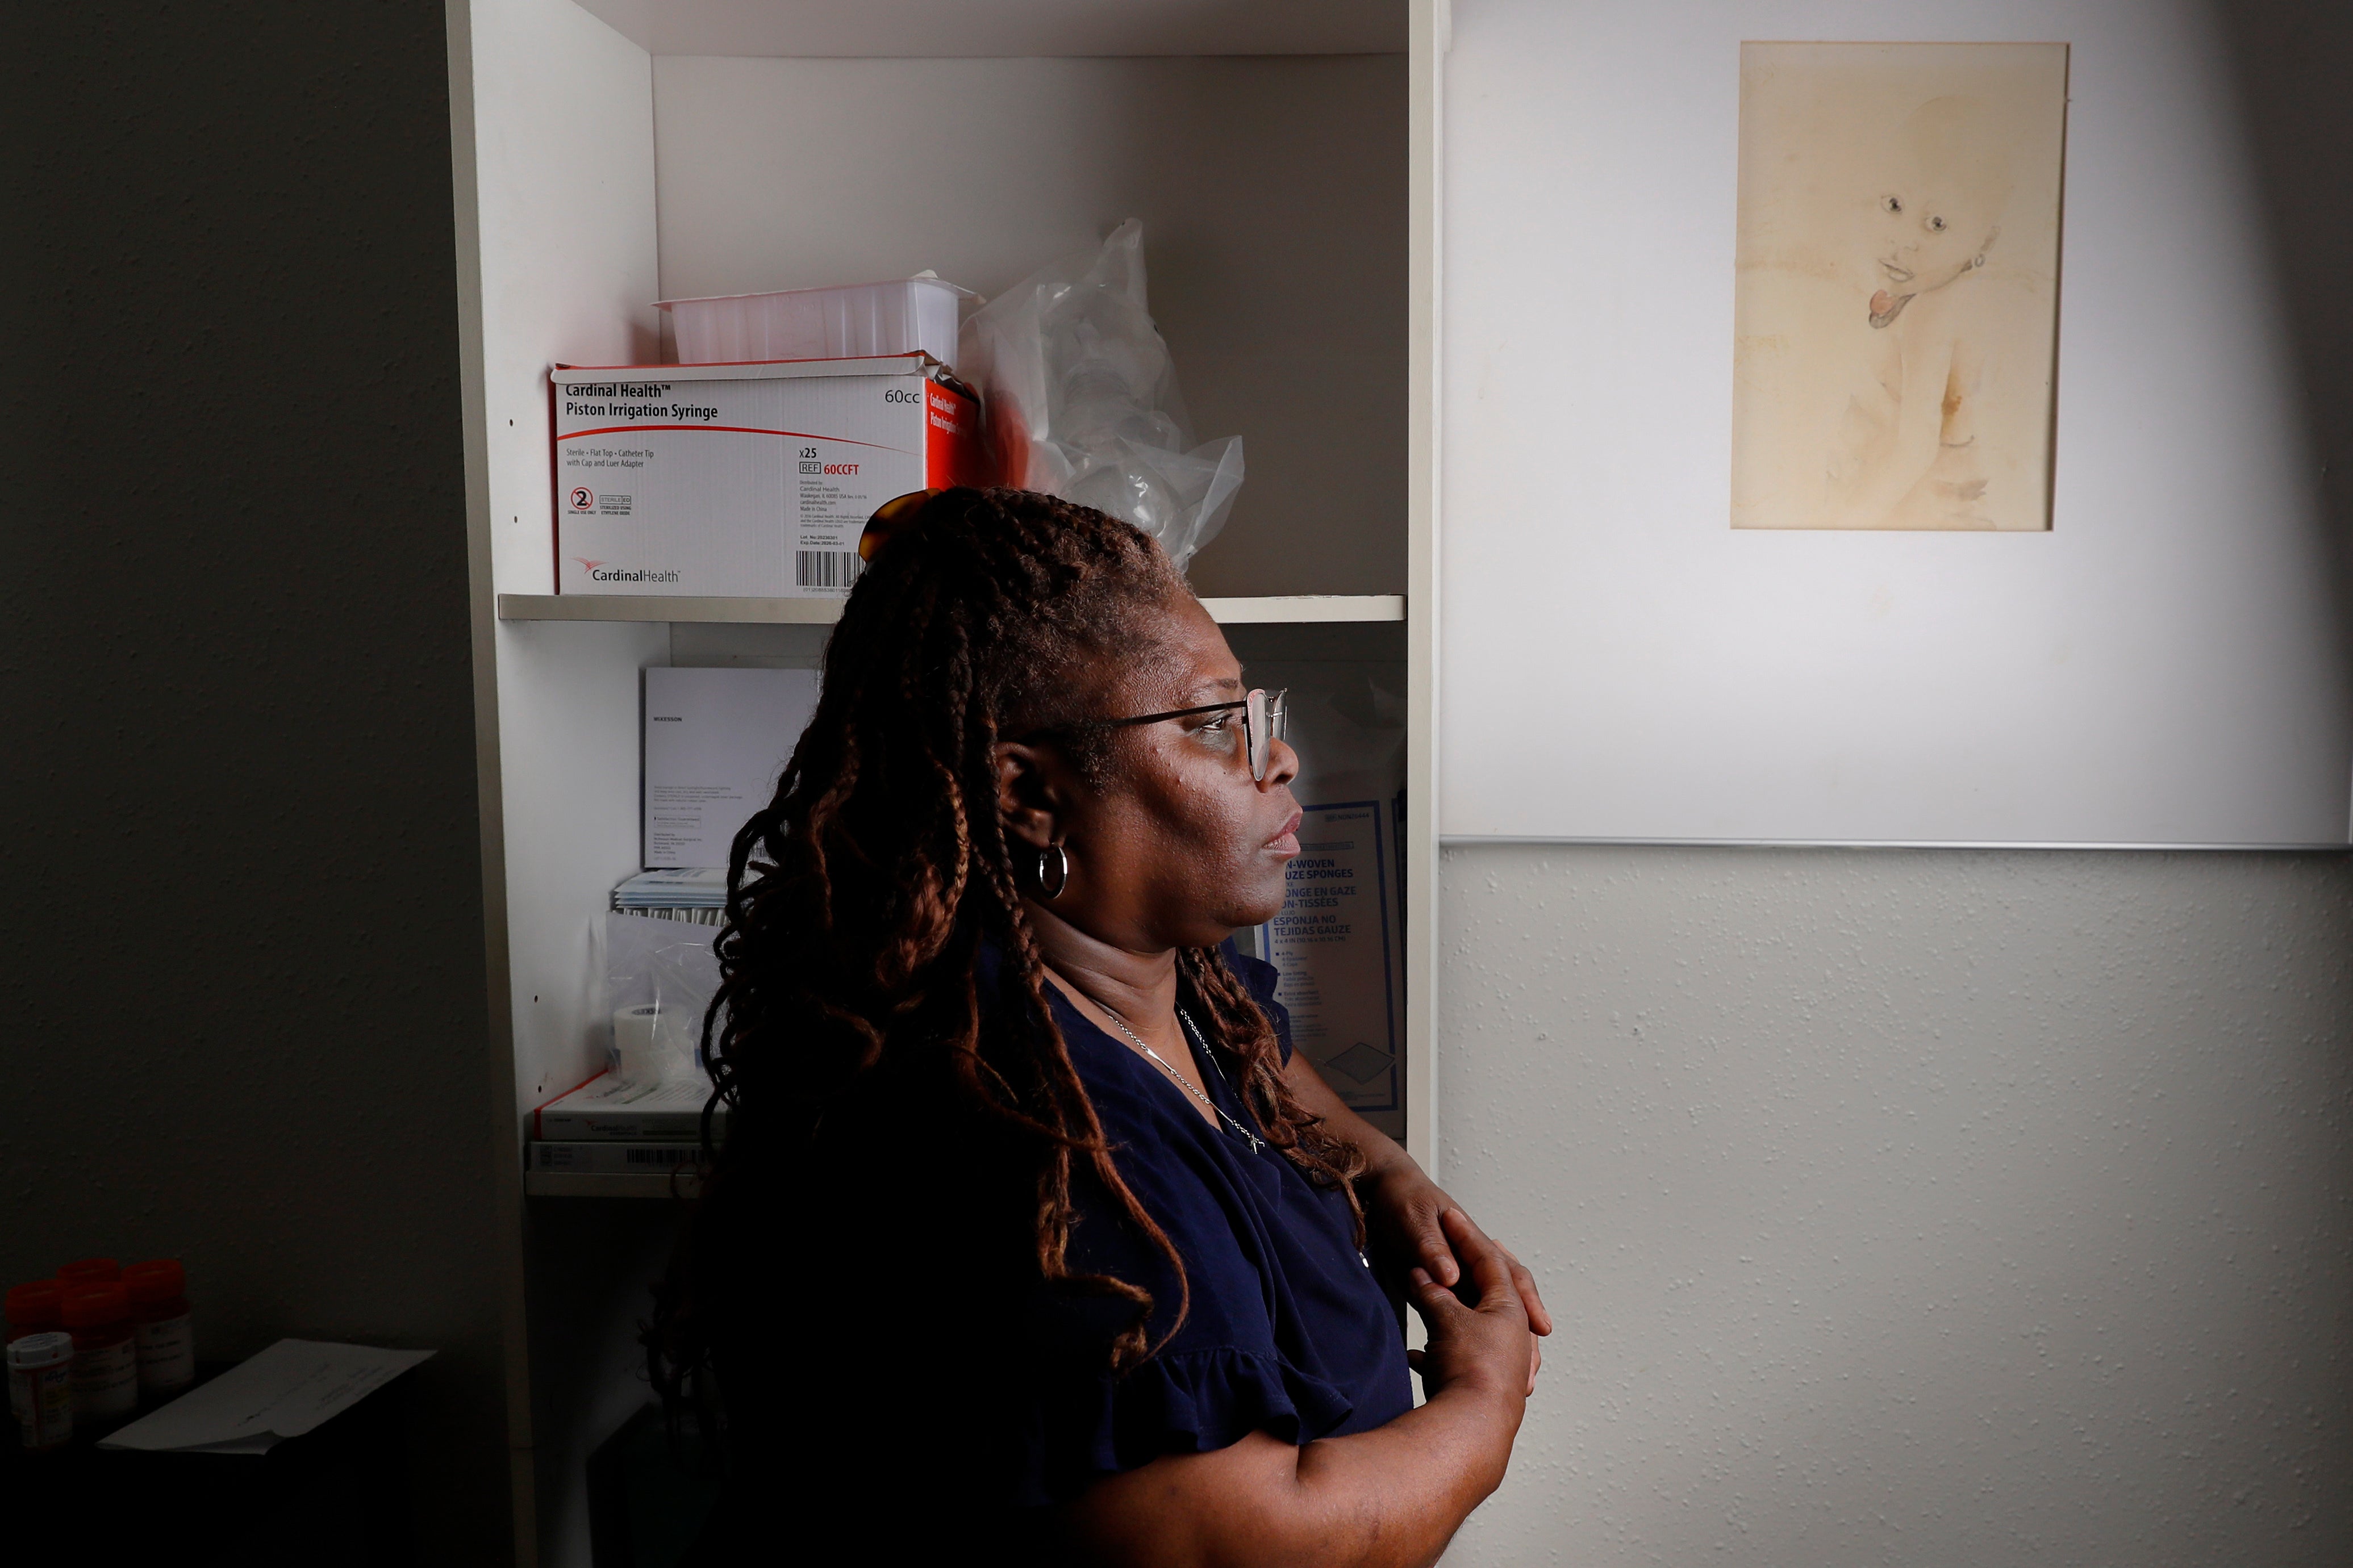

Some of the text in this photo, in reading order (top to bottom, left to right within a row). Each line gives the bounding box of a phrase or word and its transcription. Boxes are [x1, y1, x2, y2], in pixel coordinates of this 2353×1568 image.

[566, 384, 616, 397] Cardinal
[885, 390, 920, 404] 60cc
[566, 402, 717, 420] Piston Irrigation Syringe
[603, 449, 613, 458] Top
[645, 450, 654, 458] Tip
[799, 448, 816, 458] x25
[581, 459, 593, 469] Cap
[621, 460, 644, 469] Adapter
[802, 463, 859, 475] REF 60CCFT
[1286, 858, 1334, 869] N-WOVEN
[1285, 869, 1353, 880] UZE SPONGES
[1286, 886, 1357, 897] ONGE EN GAZE
[1274, 915, 1336, 926] ESPONJA NO
[1274, 925, 1351, 936] TEJIDAS GAUZE
